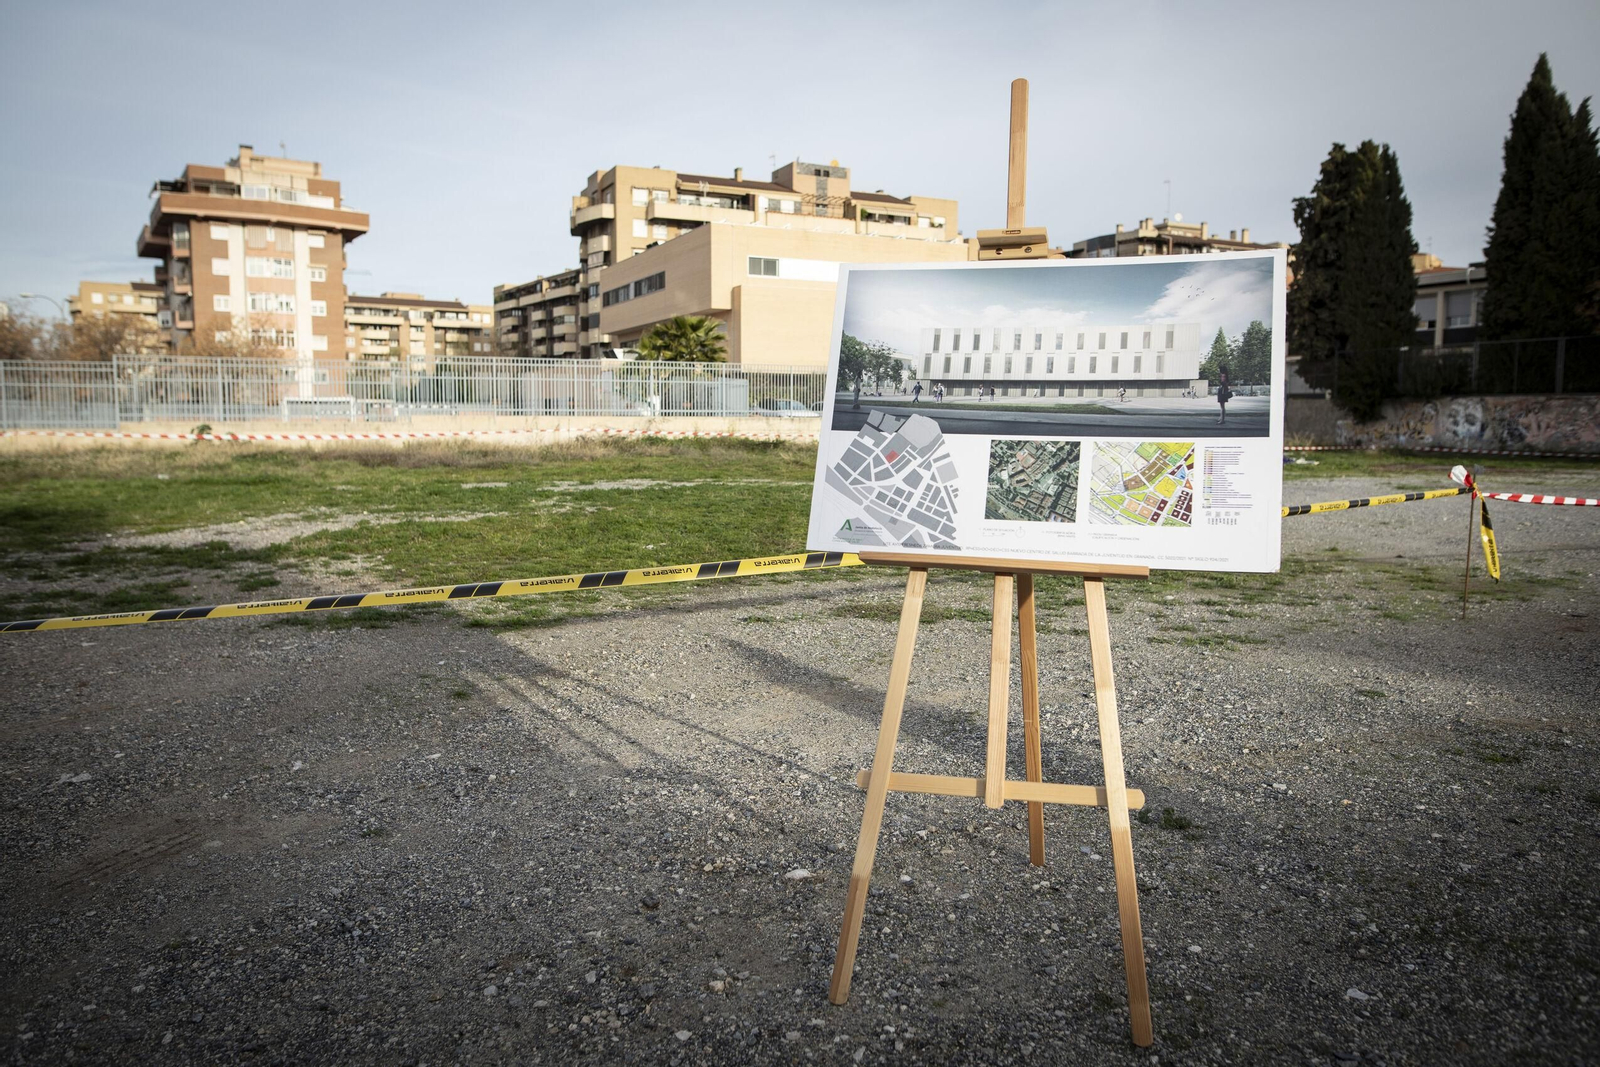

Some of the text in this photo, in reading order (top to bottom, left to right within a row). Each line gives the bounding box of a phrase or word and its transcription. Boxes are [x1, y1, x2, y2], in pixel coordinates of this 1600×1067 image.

[753, 557, 802, 568] Vialterra
[642, 567, 694, 577] Vialterra
[519, 577, 576, 587] Vialterra
[383, 588, 446, 598] Vialterra
[236, 600, 304, 610] Vialterra
